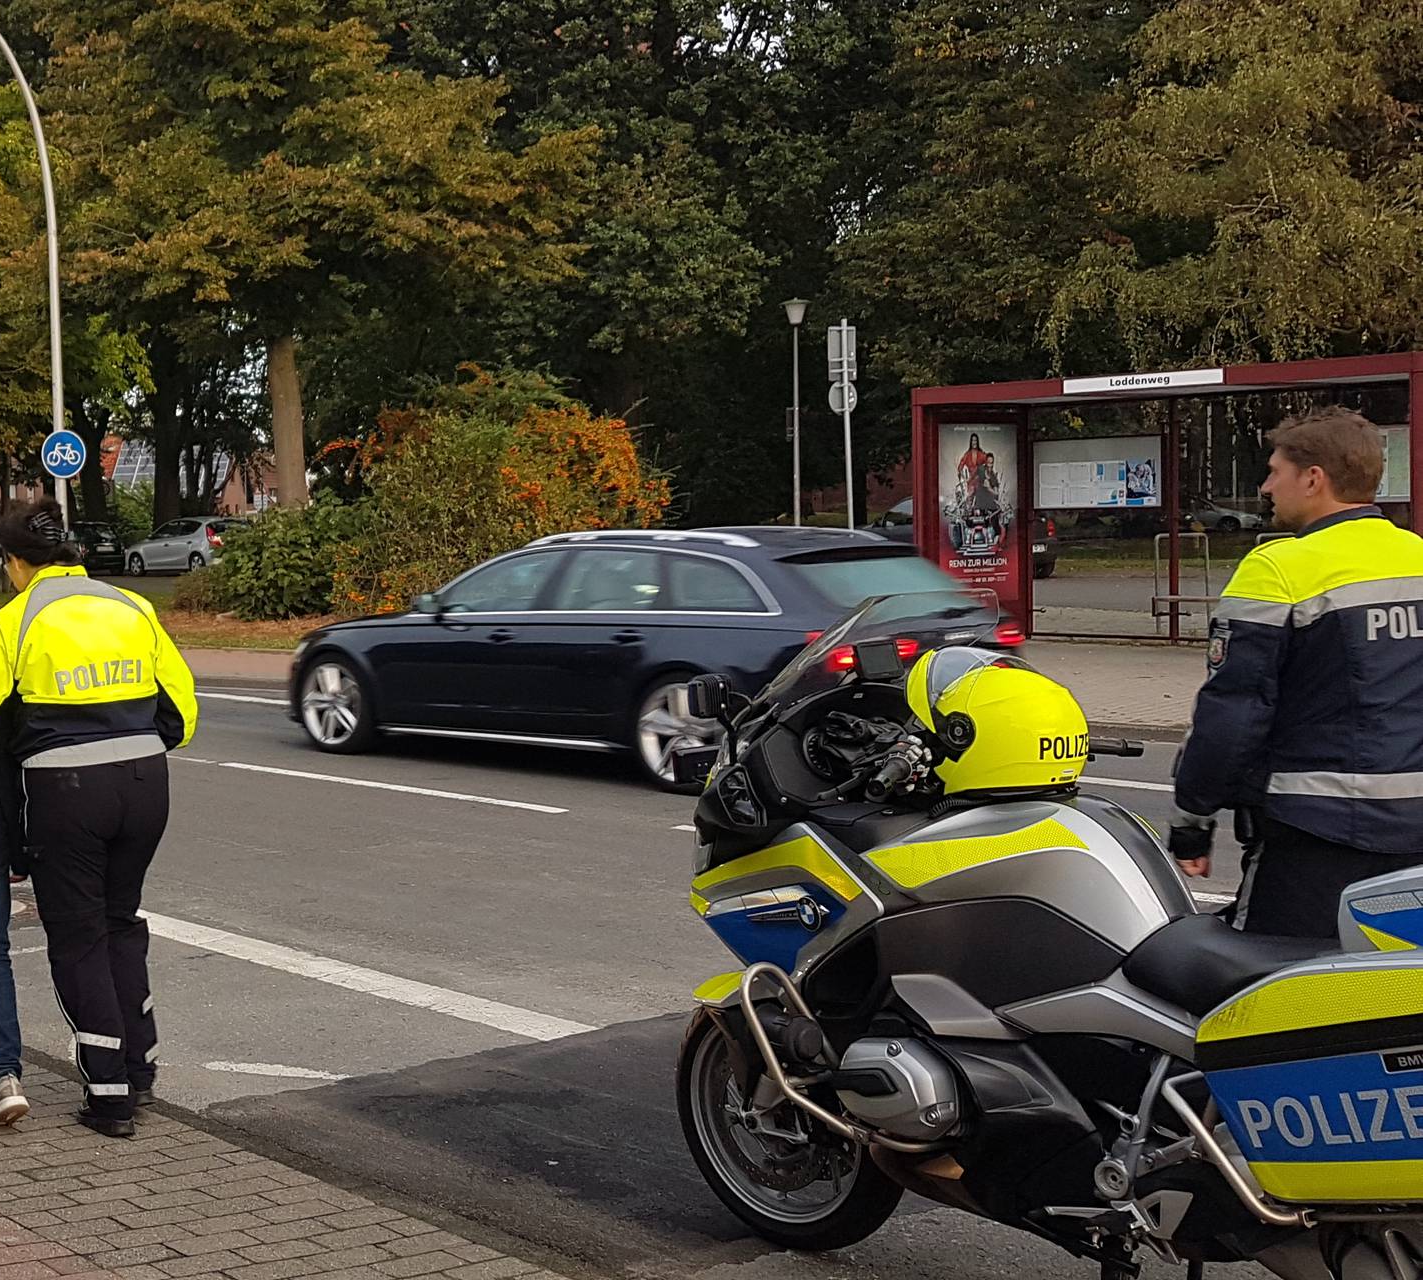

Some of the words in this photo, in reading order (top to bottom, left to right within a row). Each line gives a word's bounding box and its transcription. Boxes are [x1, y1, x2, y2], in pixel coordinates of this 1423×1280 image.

[1109, 376, 1171, 386] Loddenweg
[968, 558, 982, 568] ZUR
[983, 556, 1008, 567] MILLION
[1367, 606, 1423, 641] POL
[55, 659, 141, 696] POLIZEI
[1039, 733, 1089, 760] POLIZE
[1237, 1086, 1423, 1148] POLIZE
